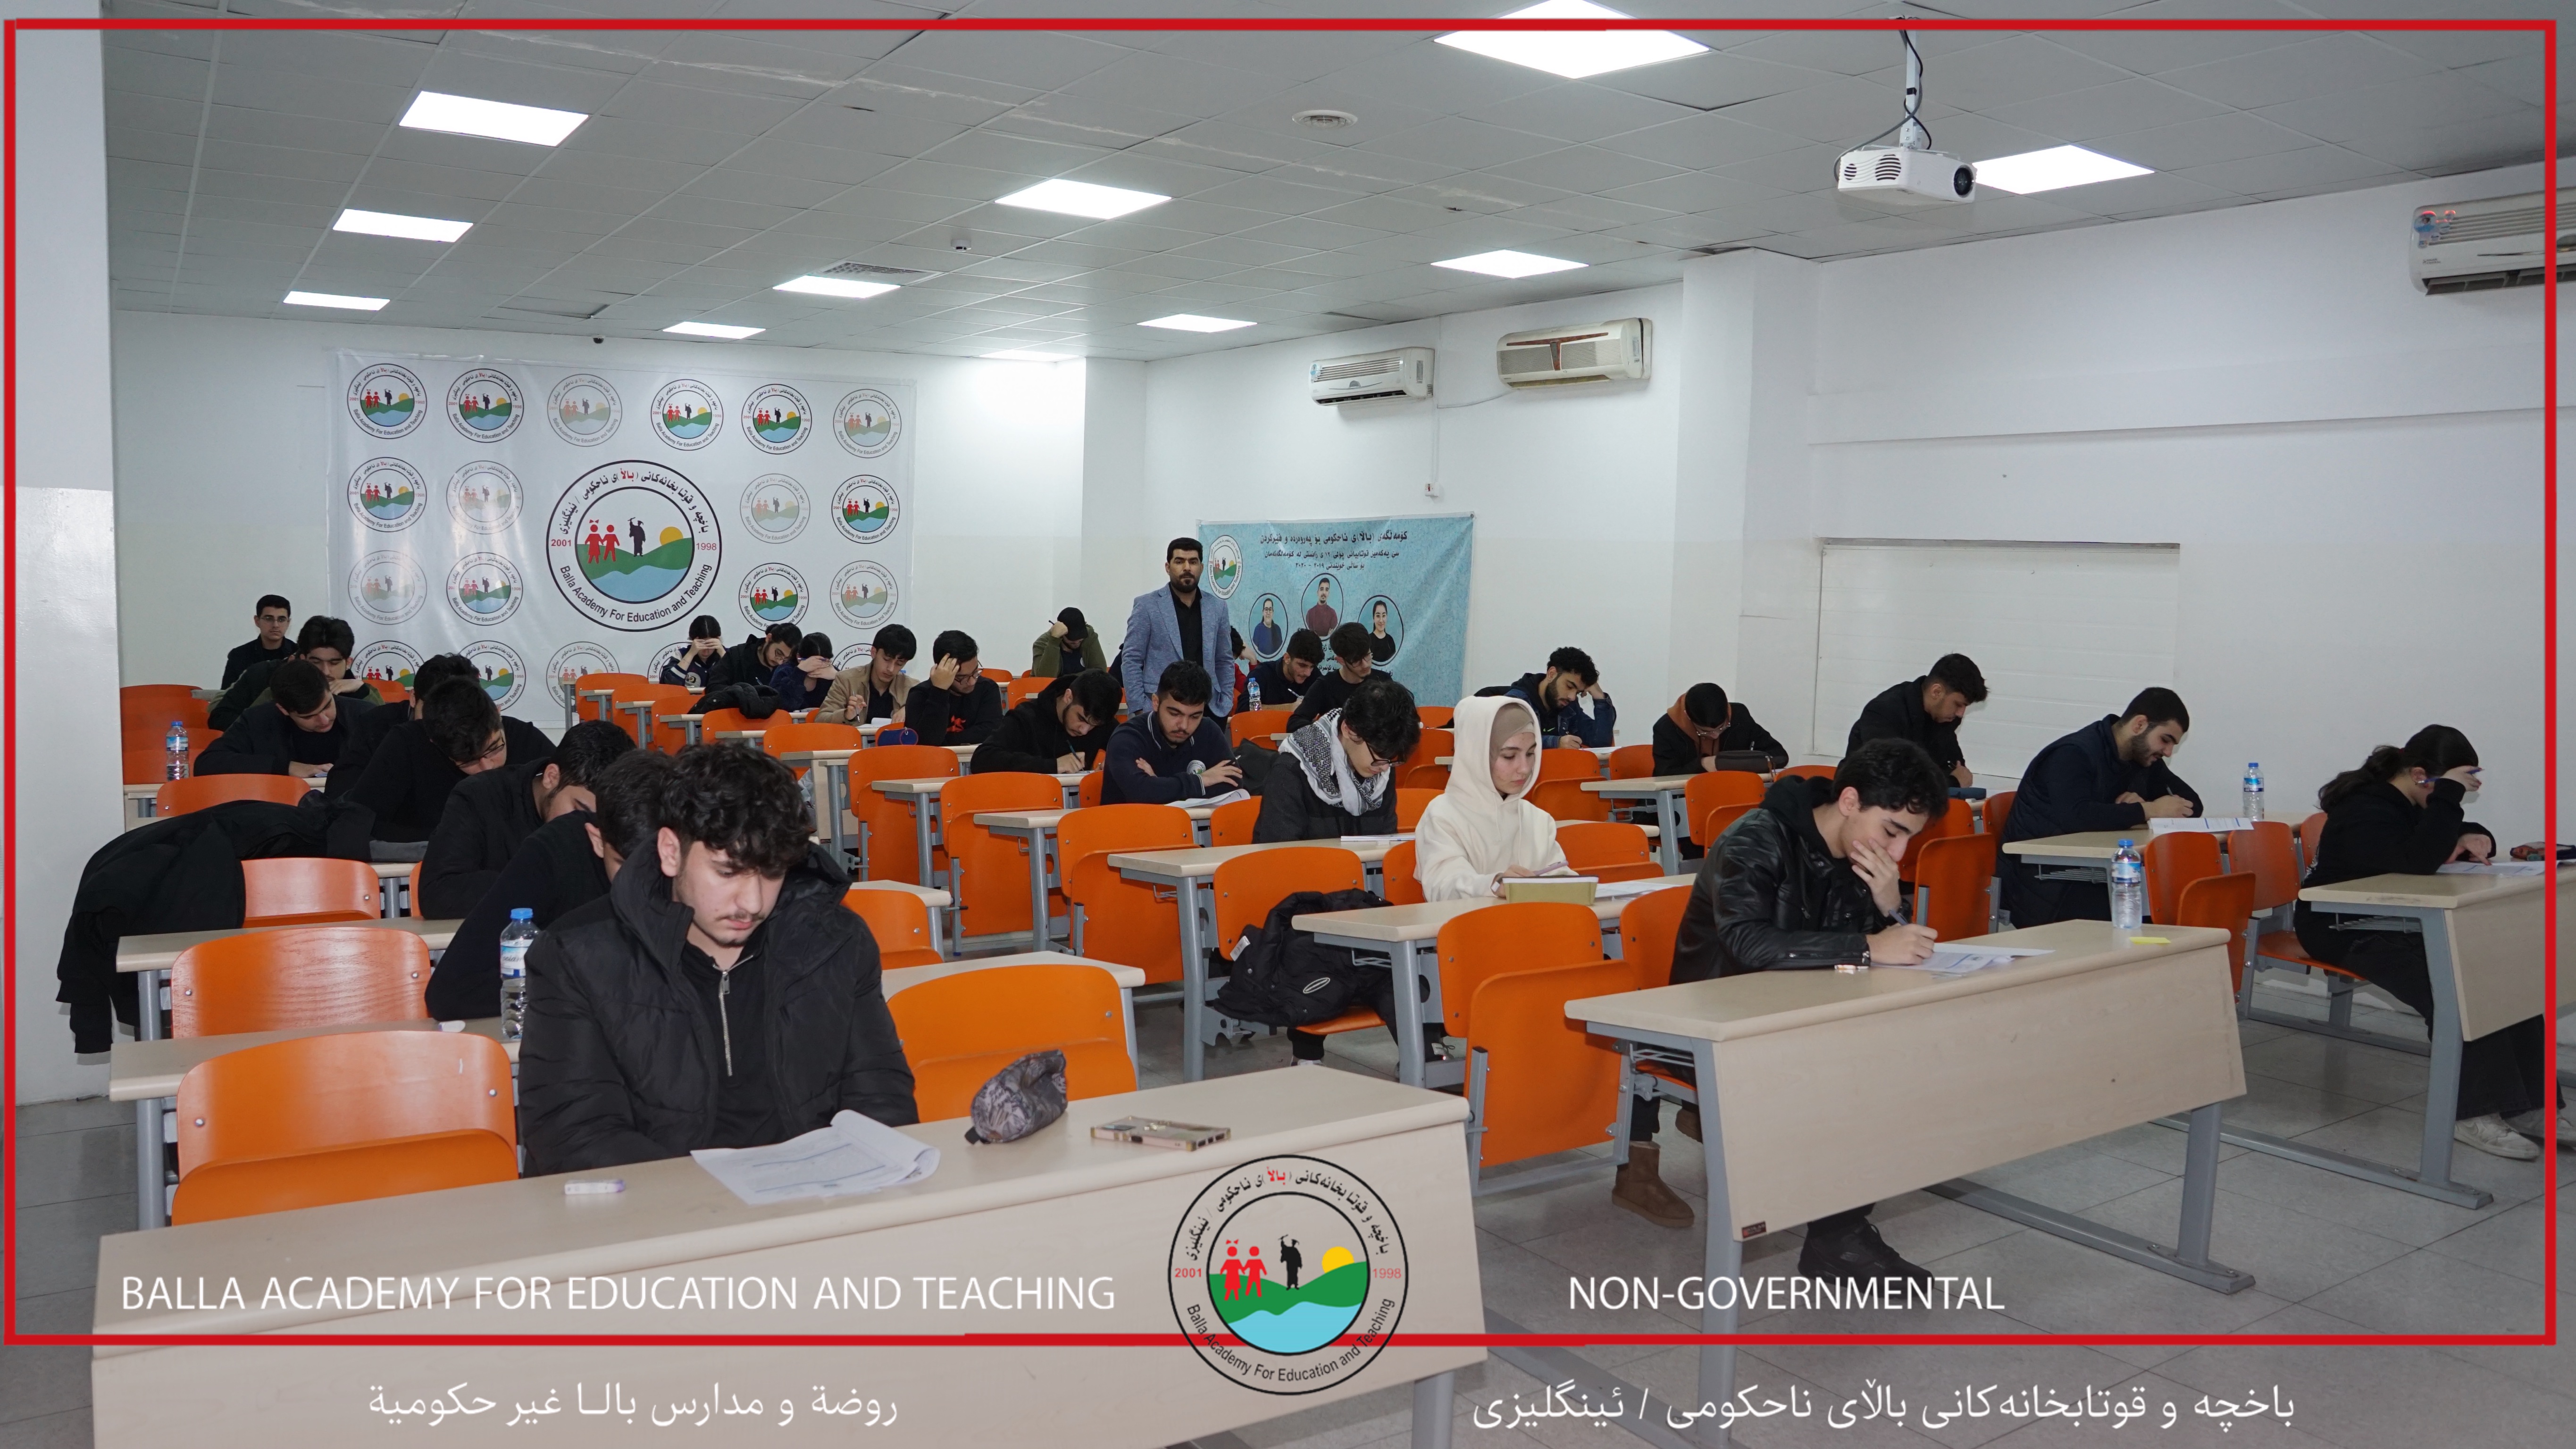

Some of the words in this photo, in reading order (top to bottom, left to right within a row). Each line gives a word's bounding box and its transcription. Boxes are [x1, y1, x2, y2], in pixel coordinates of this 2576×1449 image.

[695, 542, 717, 551] 1998
[560, 565, 576, 588] Balla
[572, 587, 609, 618] Academy
[610, 608, 625, 621] For
[627, 608, 672, 623] Education
[671, 595, 688, 611] and
[683, 564, 712, 599] Teaching
